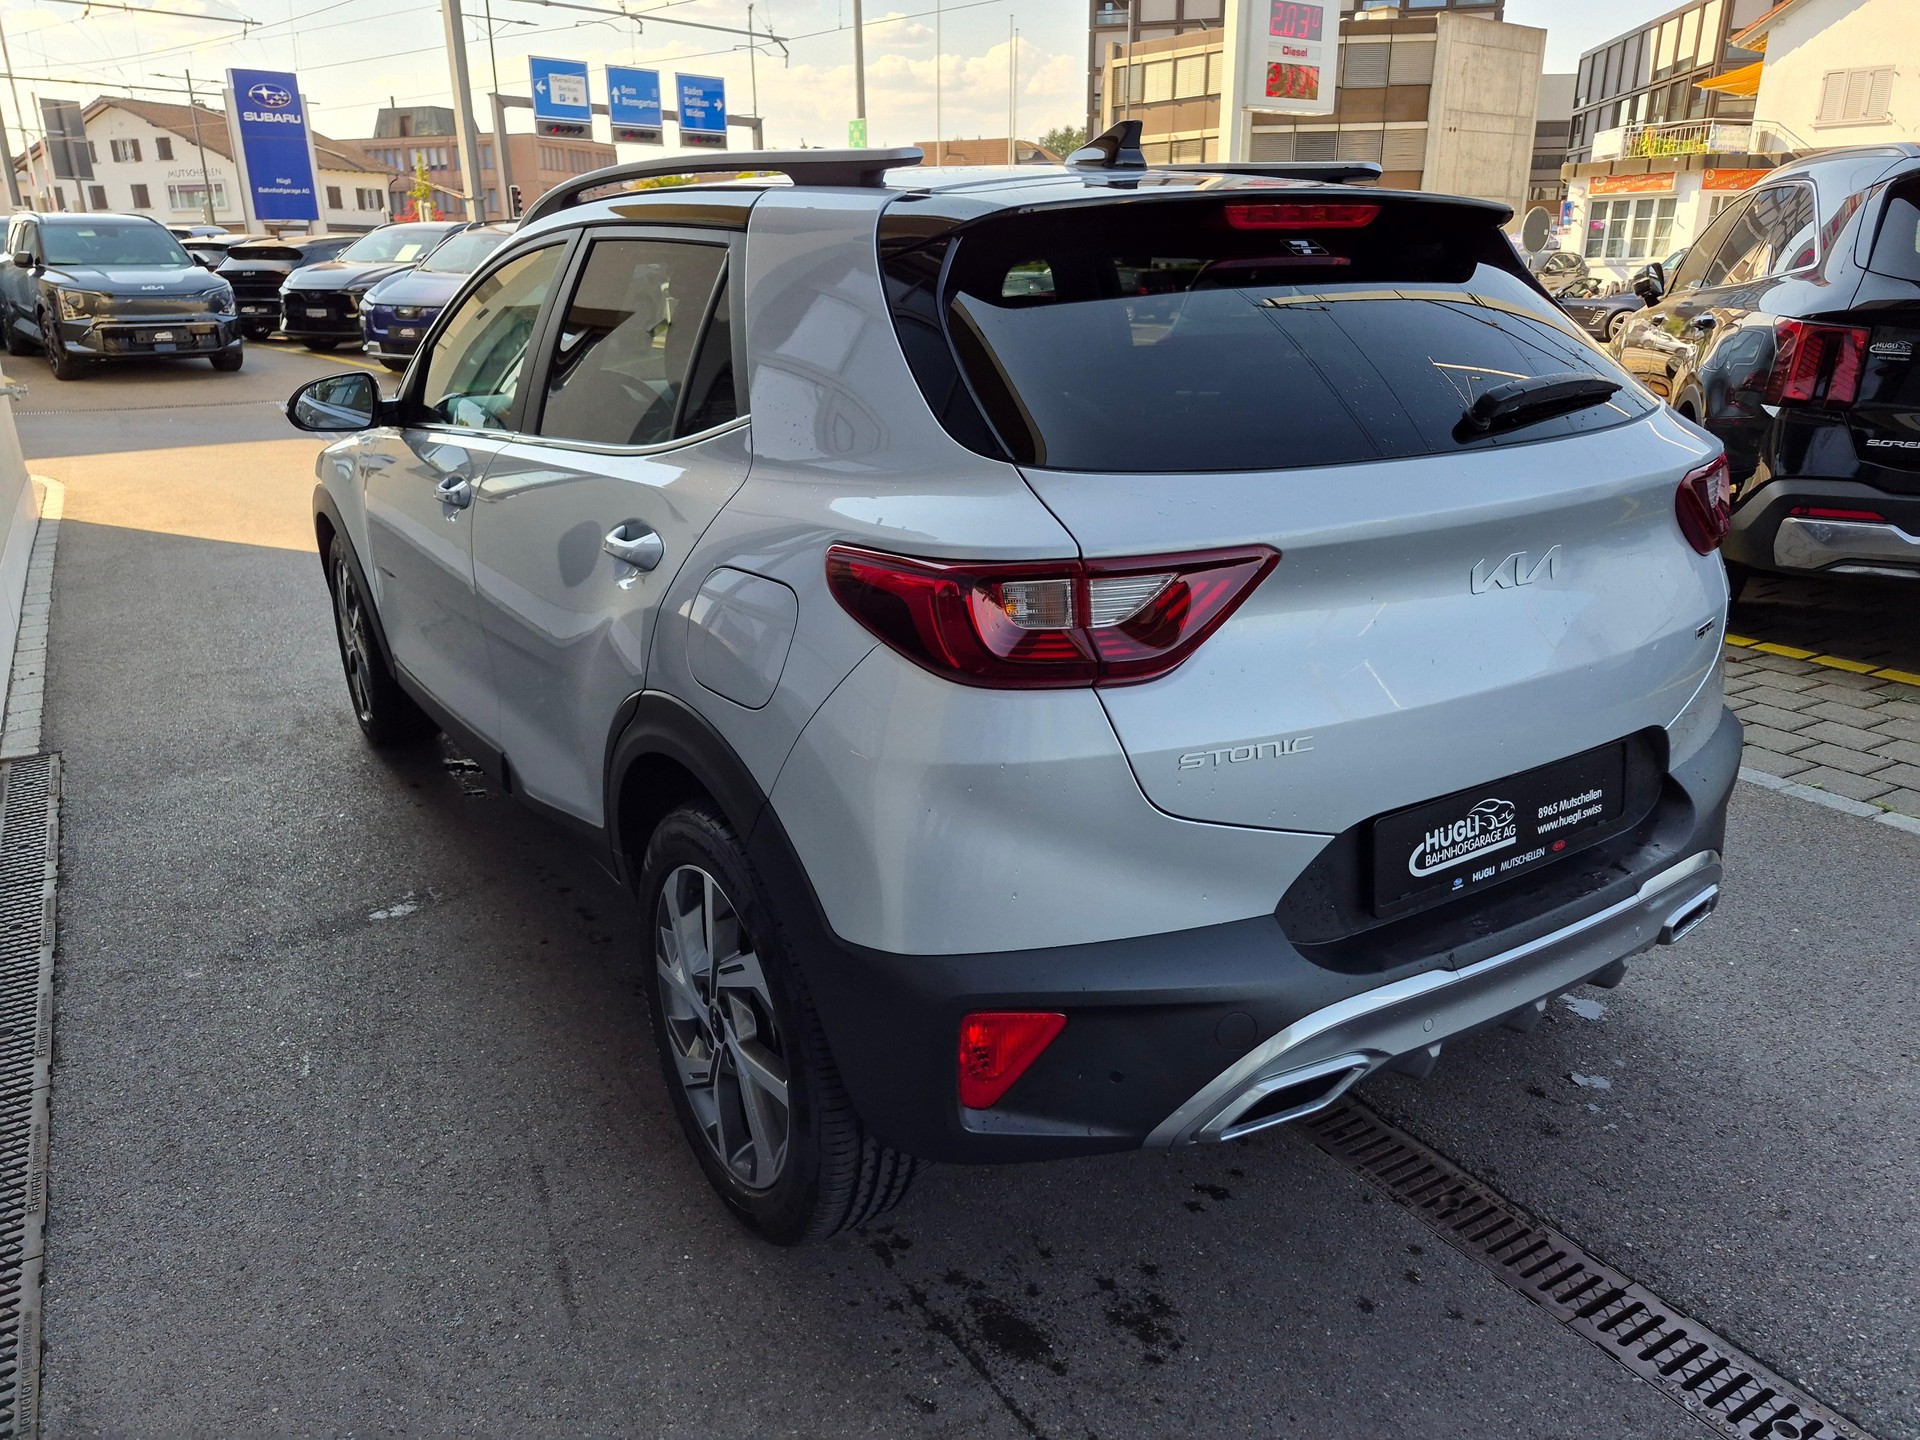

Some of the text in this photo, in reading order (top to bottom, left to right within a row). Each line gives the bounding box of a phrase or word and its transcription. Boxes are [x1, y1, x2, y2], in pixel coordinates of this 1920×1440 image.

[1282, 45, 1308, 57] Diesel
[620, 85, 637, 95] Bern
[683, 86, 704, 96] Baden
[621, 96, 659, 109] Bremgarten
[684, 97, 710, 107] Bellikon
[243, 111, 302, 124] SUBARU
[685, 108, 706, 118] Widen
[258, 186, 310, 195] Bahnhofgarage AG
[1470, 544, 1562, 595] KIA
[1178, 735, 1314, 770] STONIC
[1538, 789, 1603, 819] 8965 Mutschellen
[1537, 804, 1603, 835] www.huegli.swiss
[1425, 814, 1480, 853] HÜGLI
[1425, 824, 1516, 867] BAHNHOFGARAGE AG
[1500, 846, 1545, 872] MUTSCHELLEN
